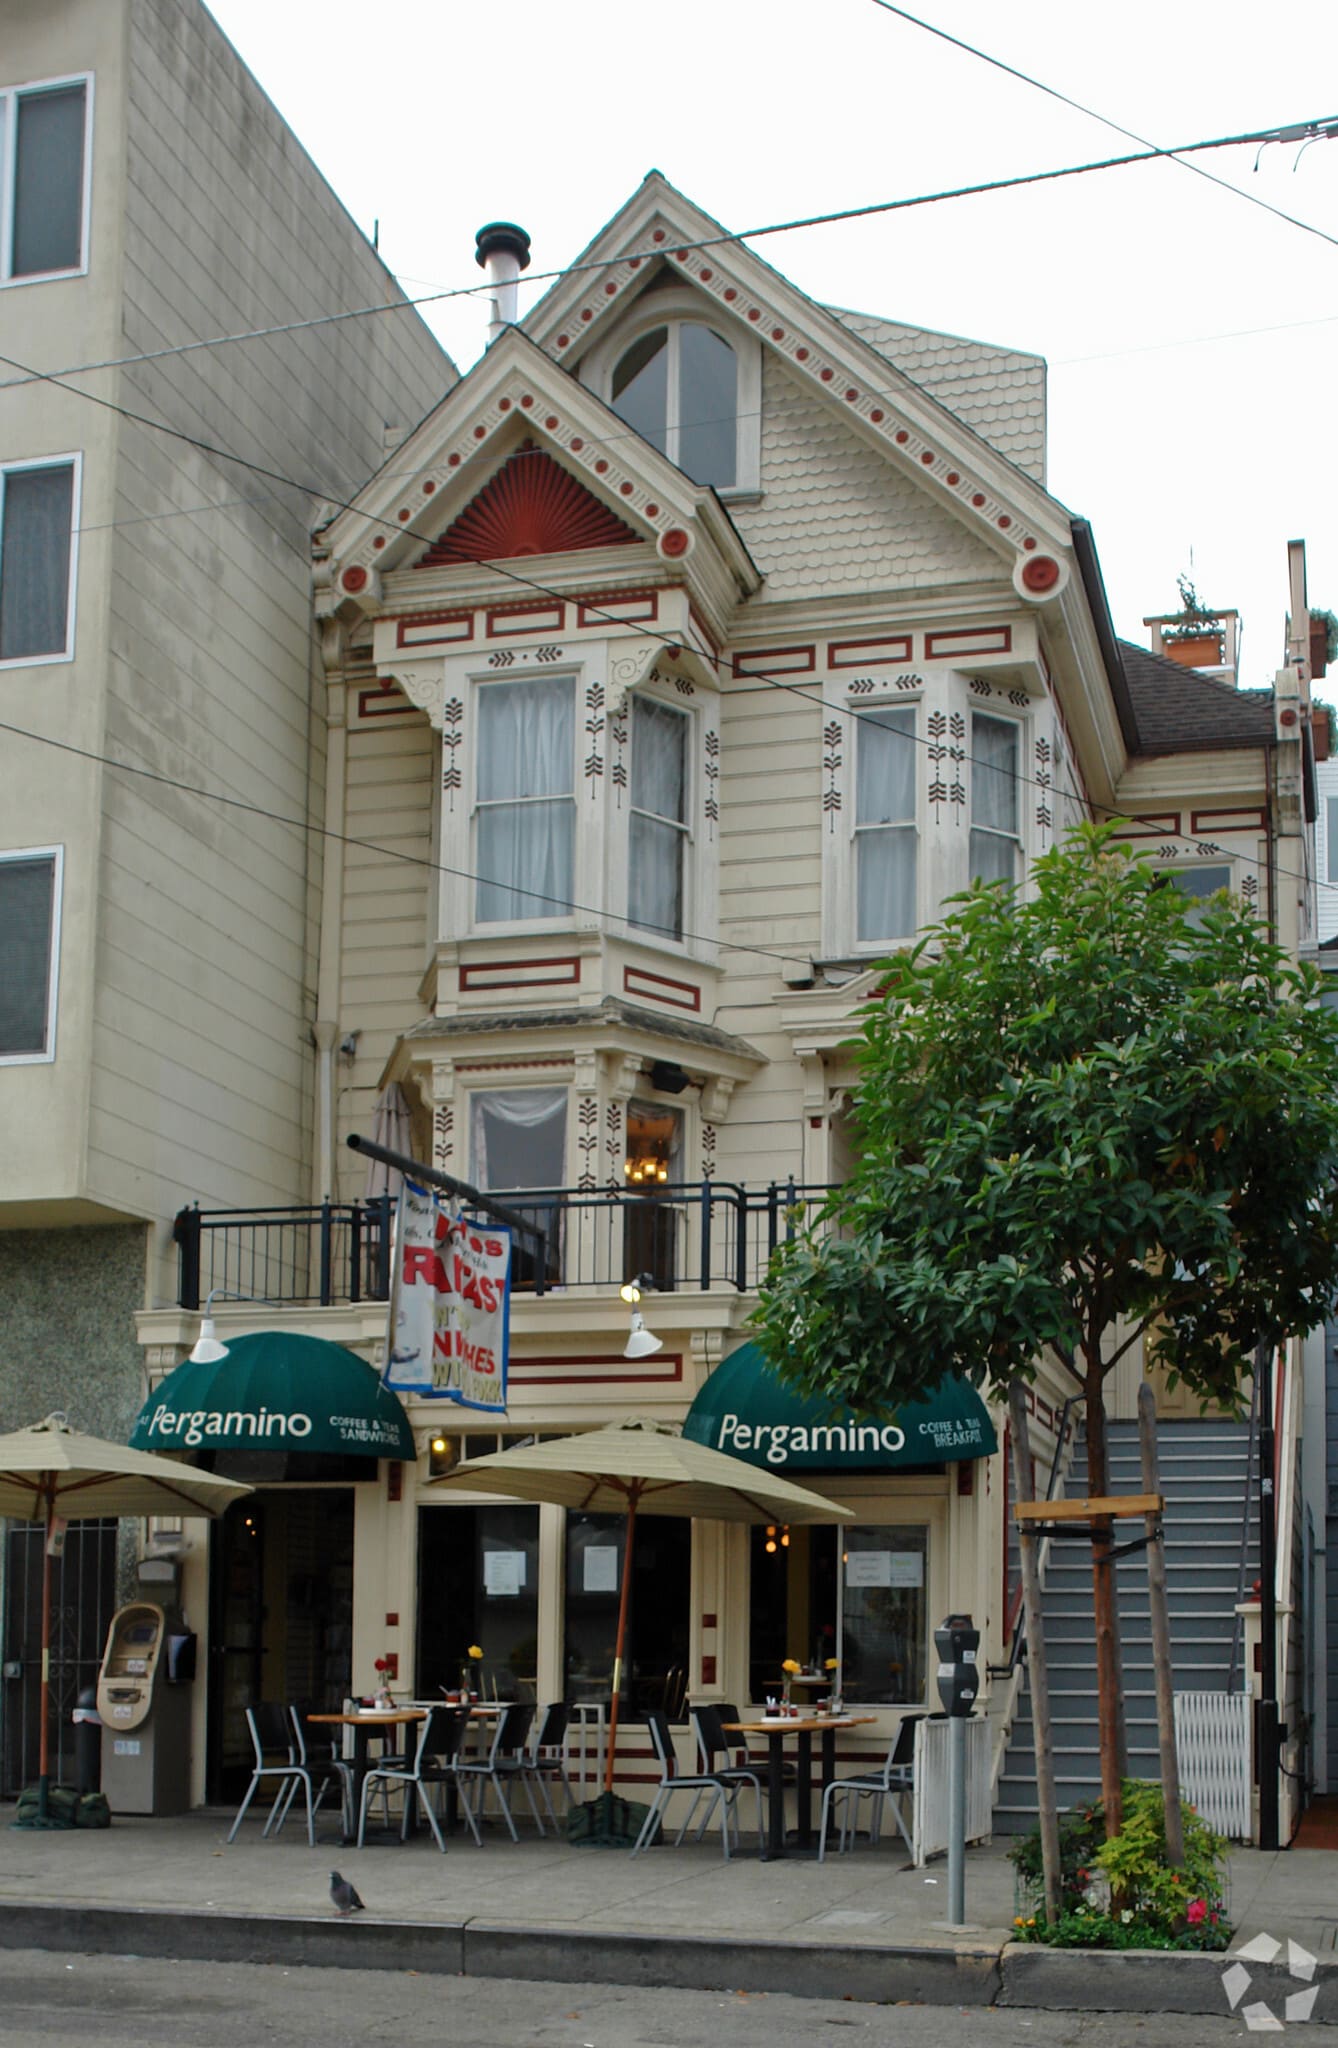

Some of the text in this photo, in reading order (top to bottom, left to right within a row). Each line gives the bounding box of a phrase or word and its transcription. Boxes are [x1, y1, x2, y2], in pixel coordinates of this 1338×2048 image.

[148, 1404, 313, 1446] Pergamino
[329, 1415, 368, 1430] COFFEE
[372, 1419, 380, 1431] &
[717, 1408, 906, 1464] Pergamino
[918, 1420, 953, 1435] COFFEE
[956, 1419, 963, 1430] &
